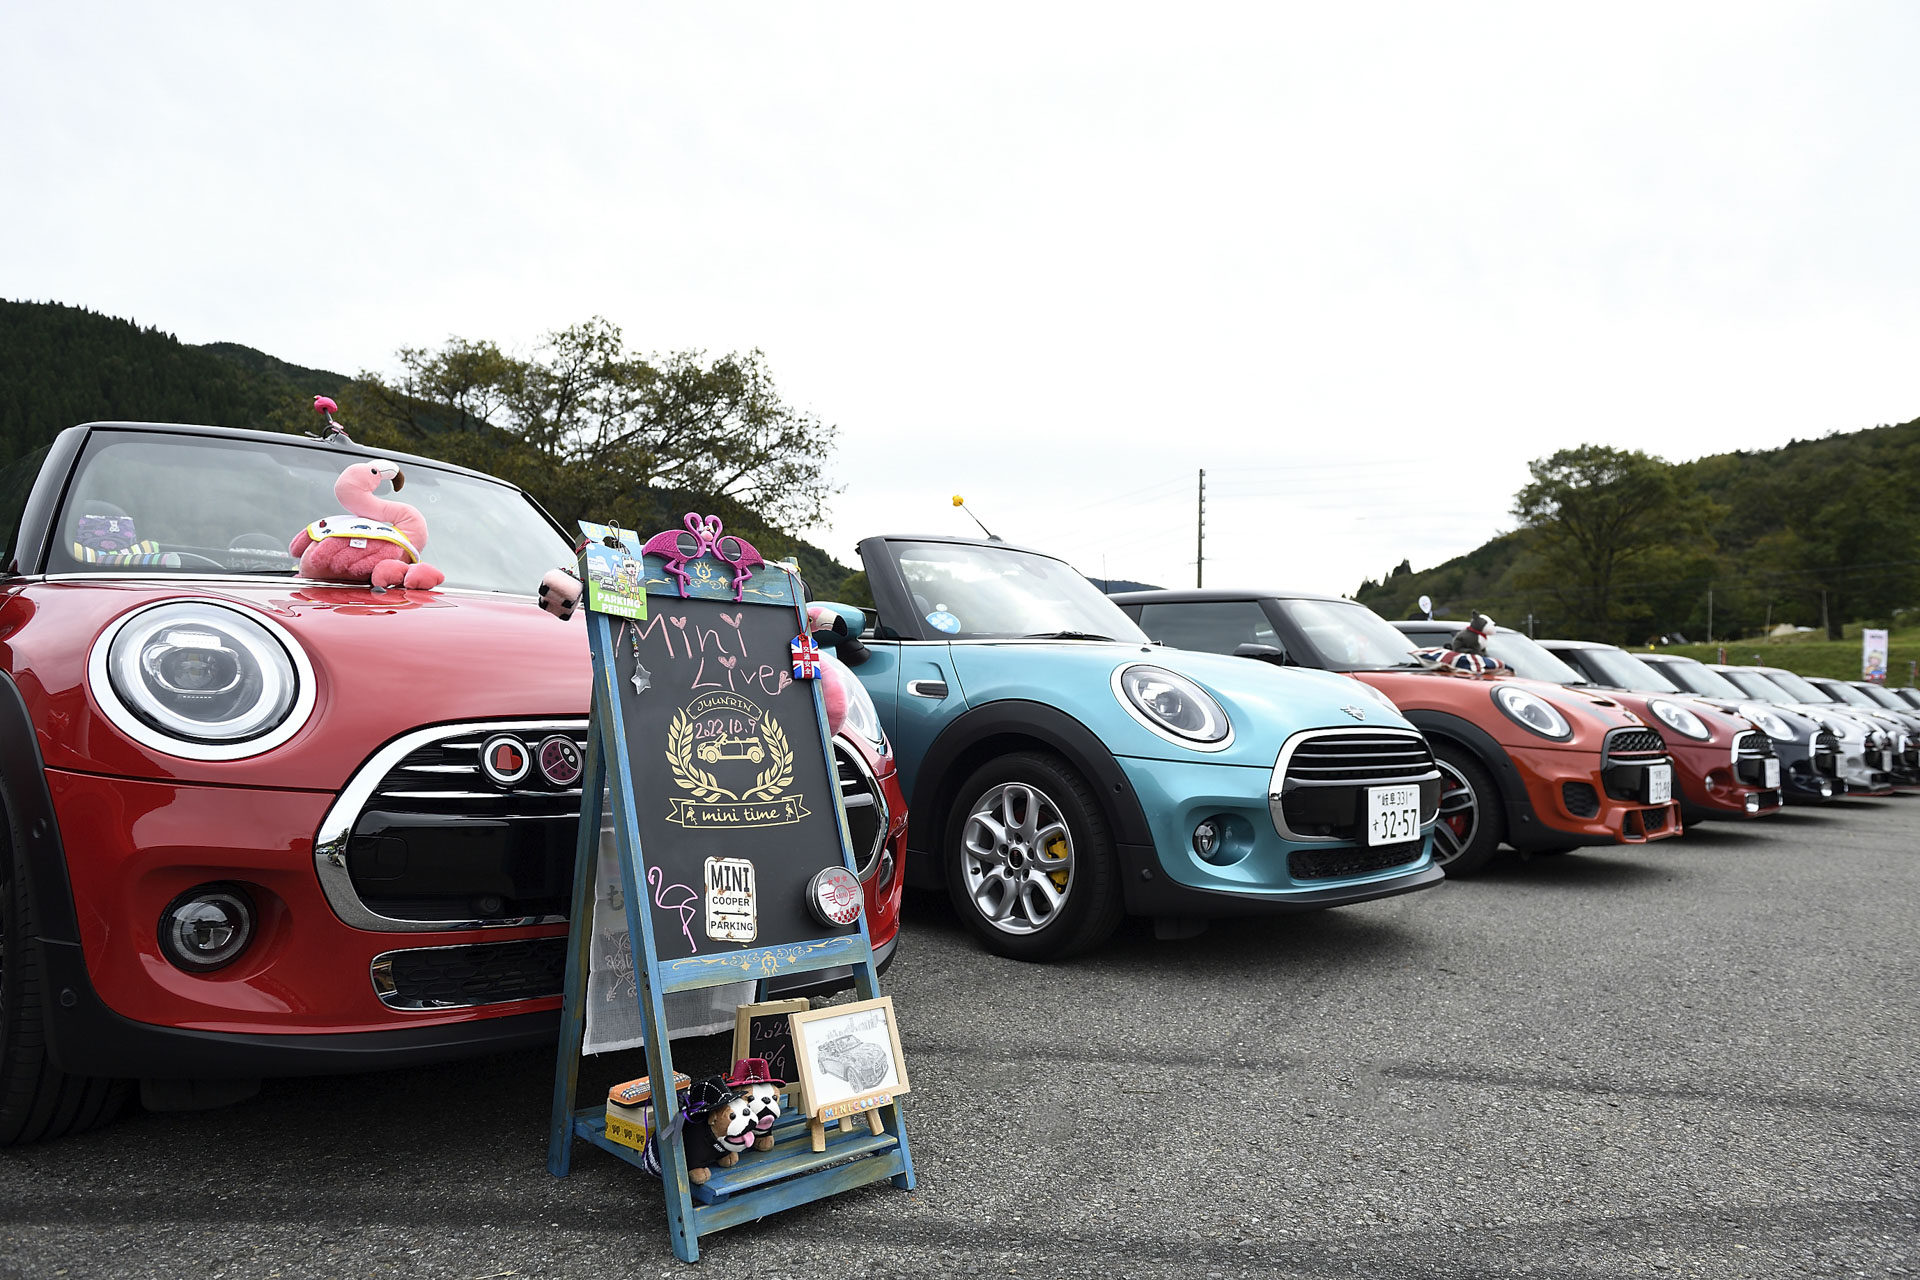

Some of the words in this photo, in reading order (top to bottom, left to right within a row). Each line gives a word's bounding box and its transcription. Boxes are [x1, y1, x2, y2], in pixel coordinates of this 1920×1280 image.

[597, 592, 641, 608] PARKING
[601, 603, 637, 616] PERMIT
[615, 612, 748, 659] Mini
[803, 646, 811, 674] 交通安全
[691, 656, 784, 695] Live
[702, 808, 740, 822] mini
[743, 807, 780, 822] time
[1381, 808, 1417, 839] 32-57
[711, 864, 750, 892] MINI
[712, 896, 750, 906] COOPER
[710, 920, 753, 931] PARKING
[753, 1021, 792, 1041] 2022
